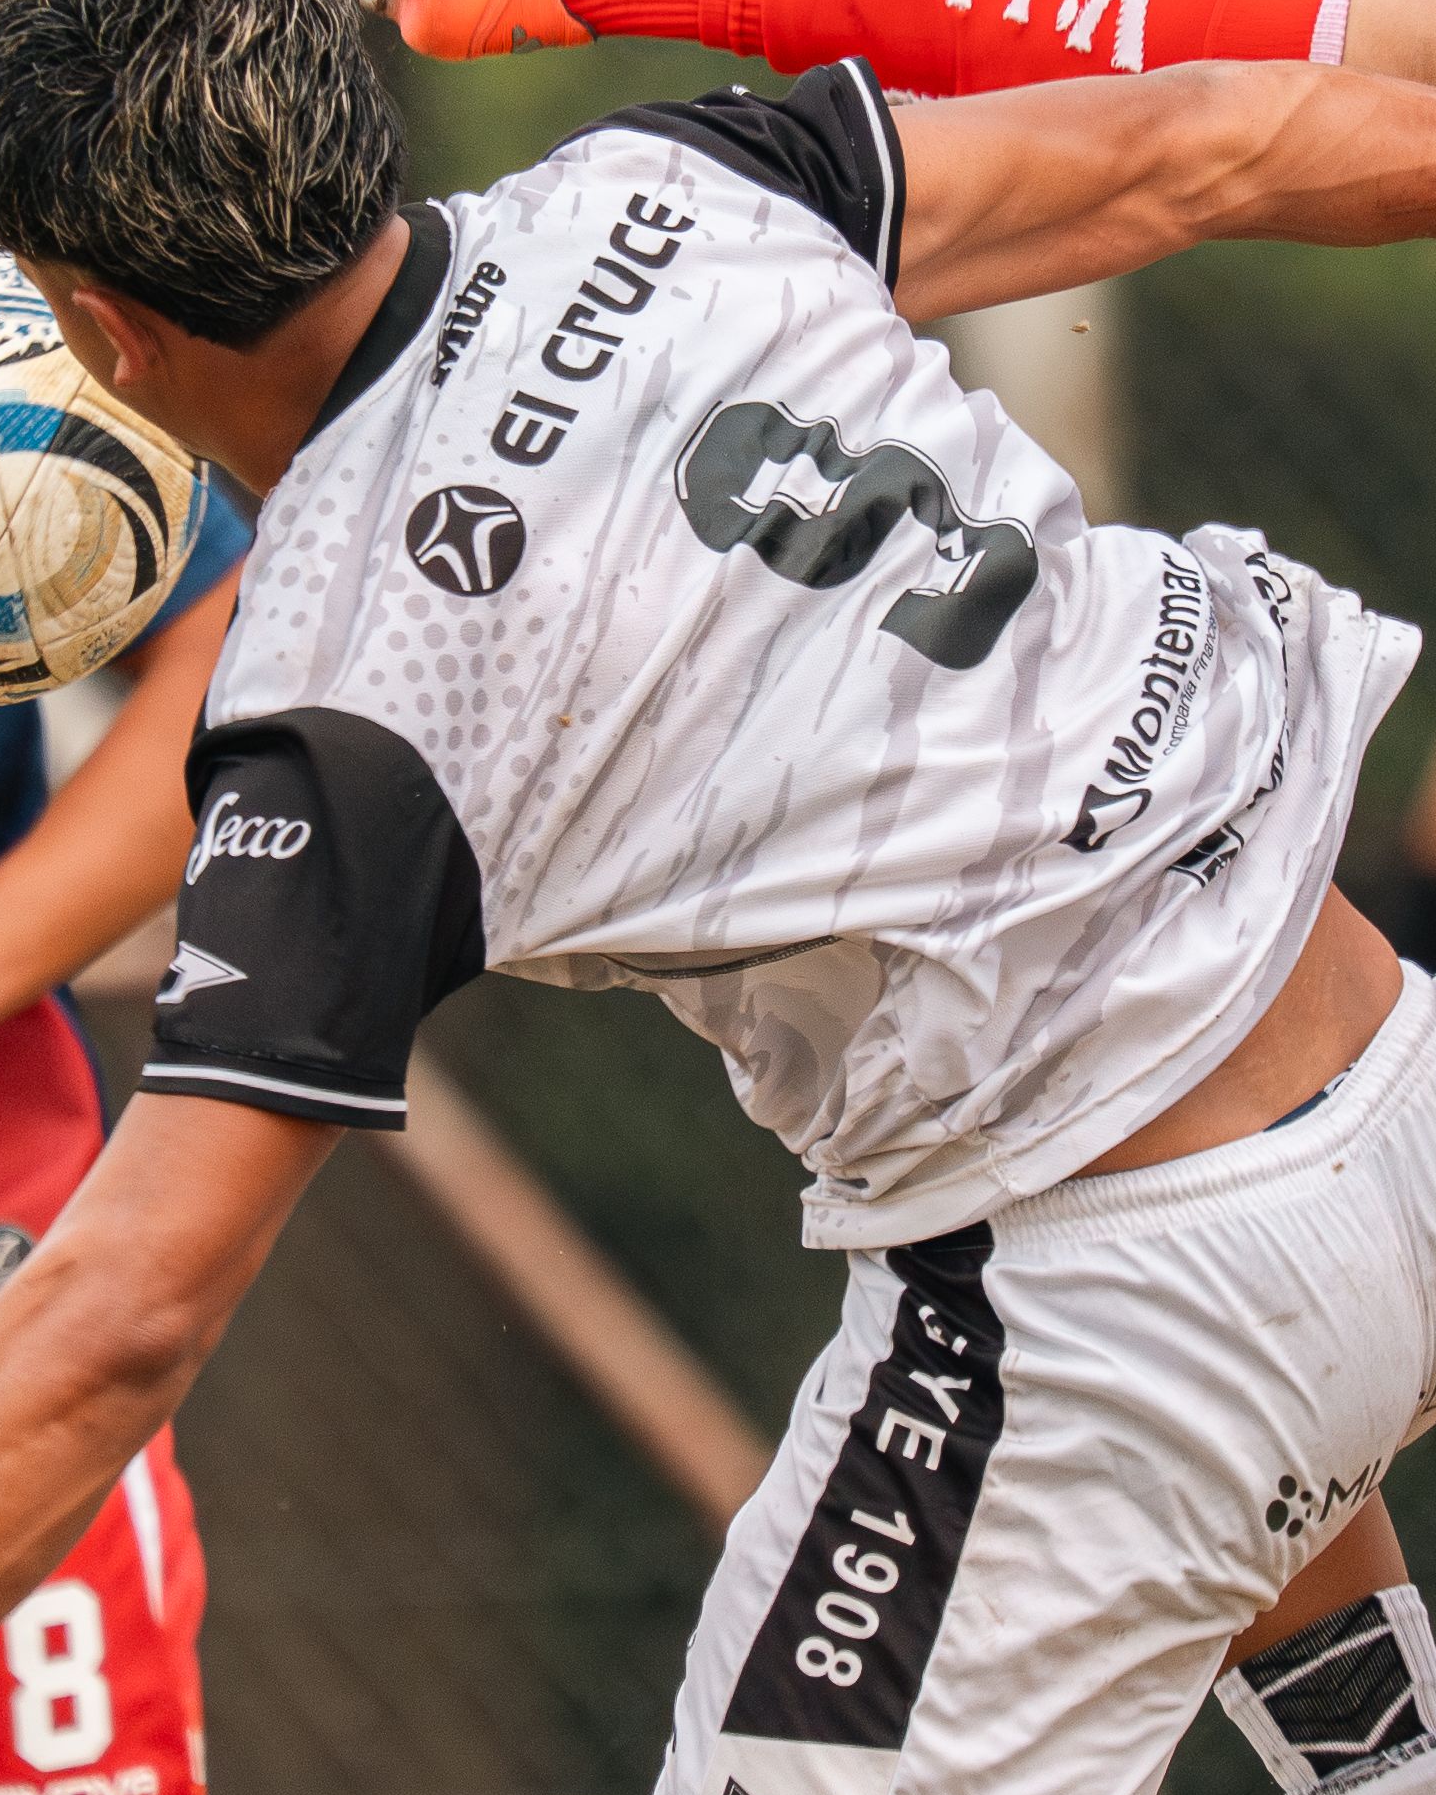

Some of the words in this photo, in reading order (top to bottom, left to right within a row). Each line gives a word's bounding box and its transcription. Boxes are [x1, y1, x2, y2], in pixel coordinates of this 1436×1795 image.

[1104, 551, 1202, 785] Montemar
[185, 791, 312, 886] Secco
[4, 1578, 116, 1773] 8
[794, 1509, 916, 1688] 1908
